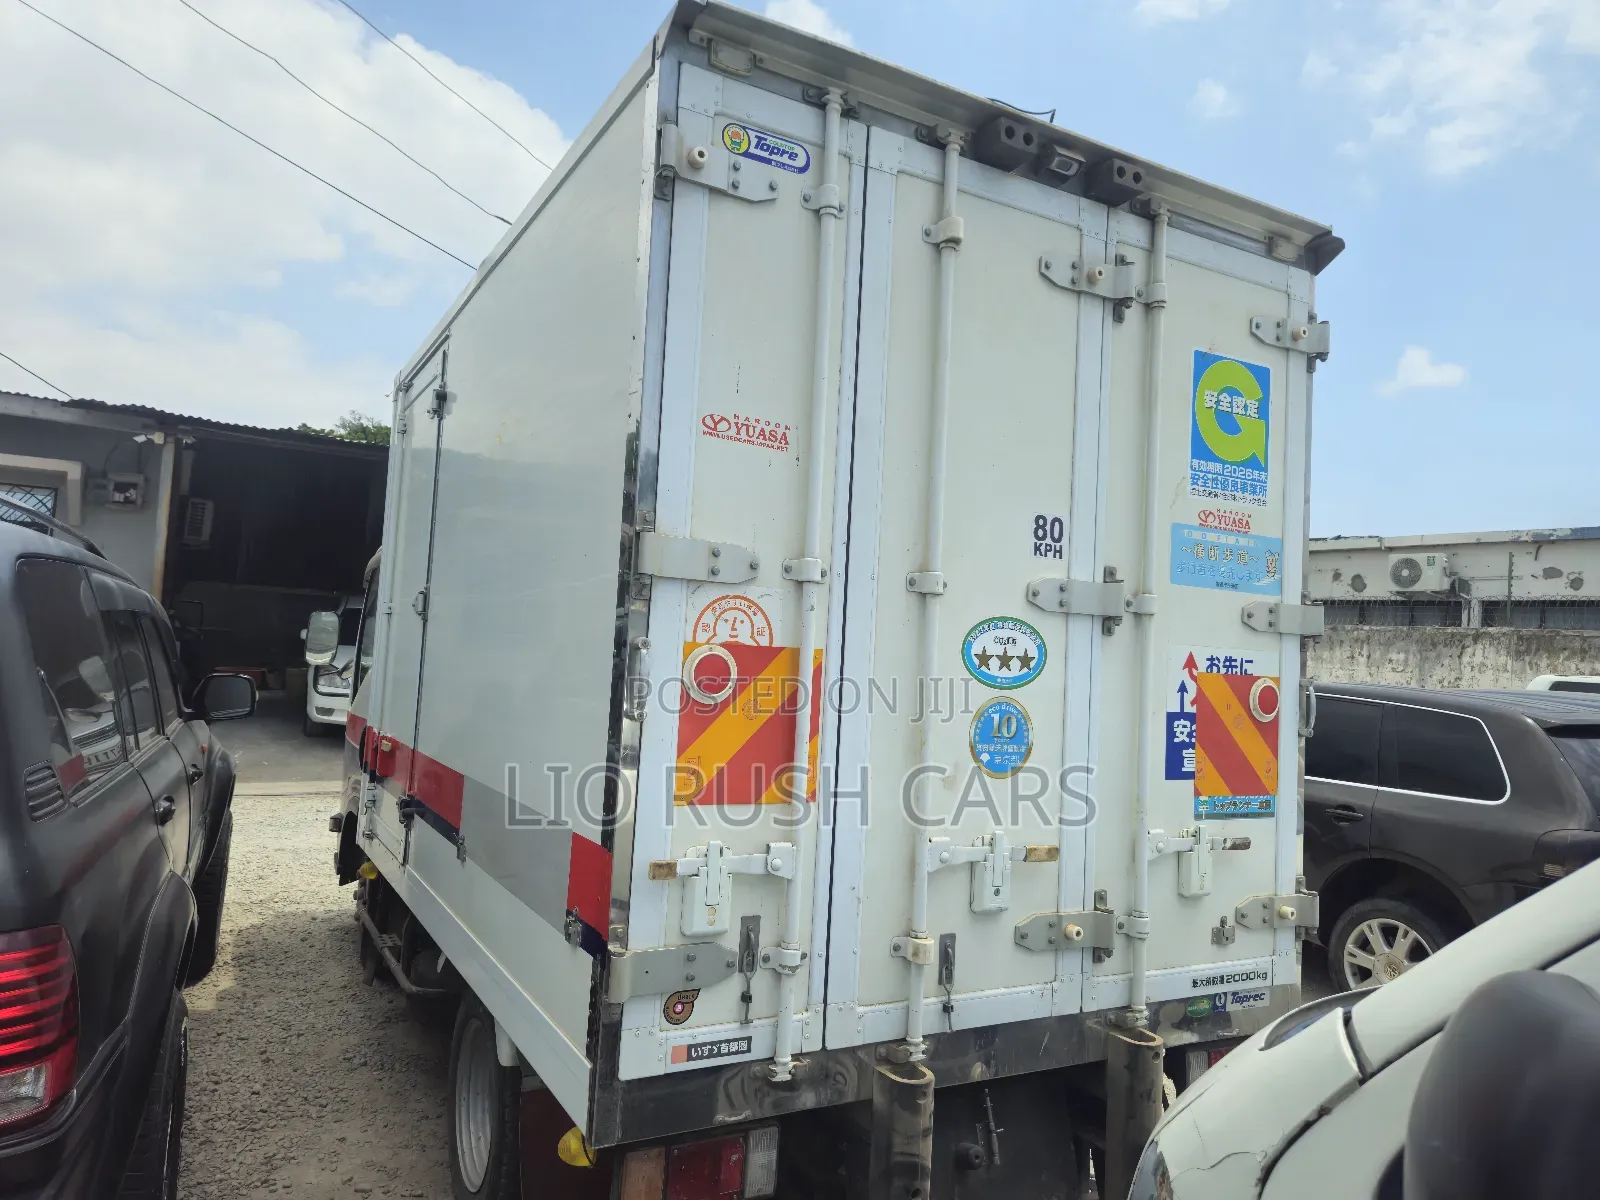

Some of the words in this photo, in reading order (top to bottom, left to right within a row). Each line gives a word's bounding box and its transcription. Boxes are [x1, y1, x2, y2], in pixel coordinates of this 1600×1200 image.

[753, 134, 799, 161] Topre
[1204, 389, 1260, 420] 安全認定
[733, 413, 791, 432] HAROON
[733, 421, 790, 446] YUASA
[1033, 514, 1064, 544] 80
[1217, 514, 1251, 531] YUASA
[1033, 541, 1063, 560] KPH
[1205, 654, 1254, 676] お先に
[990, 713, 1018, 738] 10
[1230, 991, 1266, 1005] Toprec
